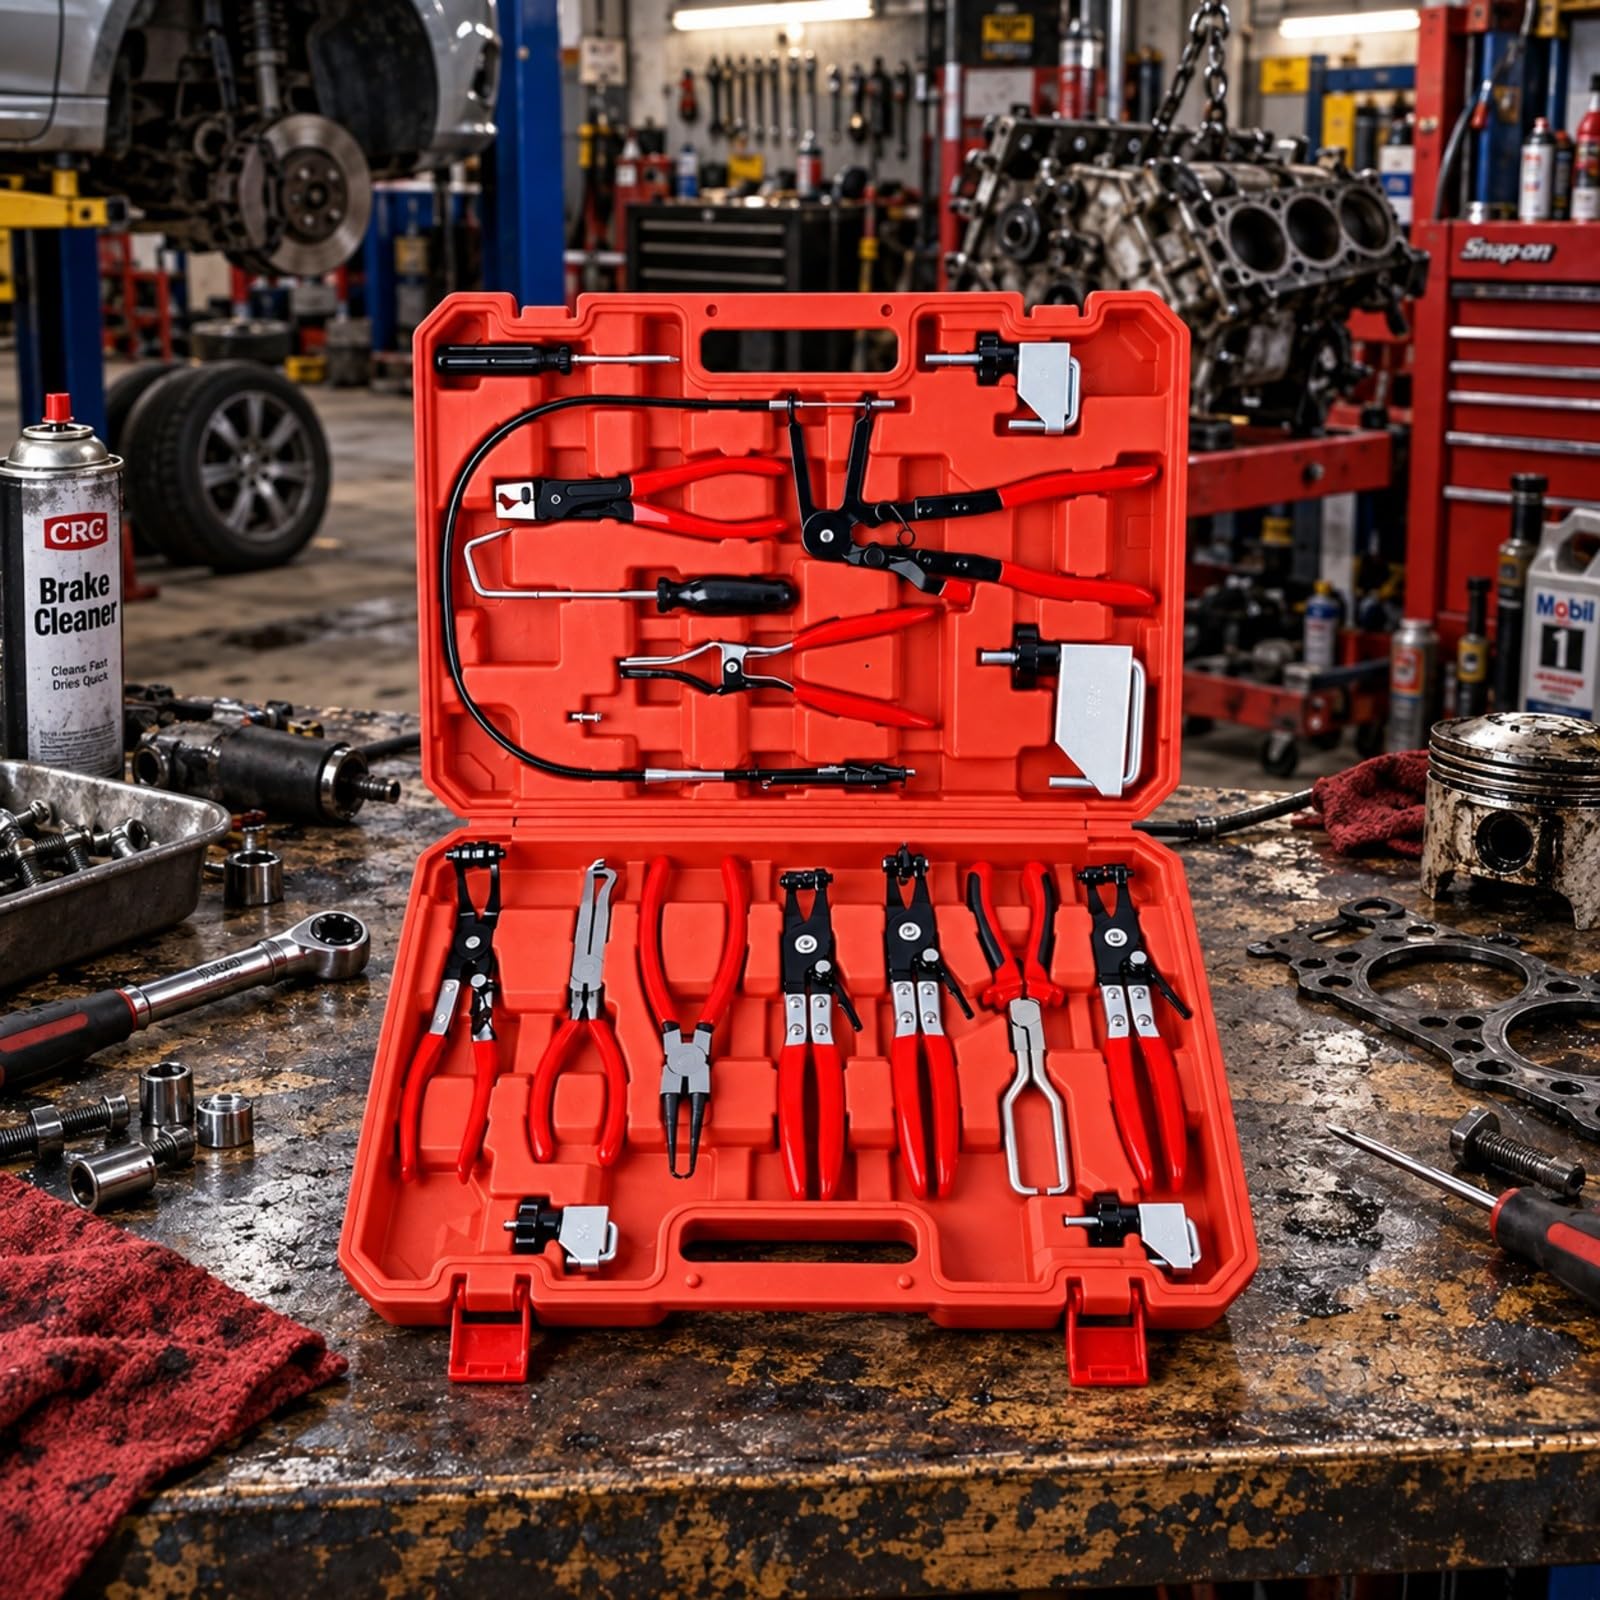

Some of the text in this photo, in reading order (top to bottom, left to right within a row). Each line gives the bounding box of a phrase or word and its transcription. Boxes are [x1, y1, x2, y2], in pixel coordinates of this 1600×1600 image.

[1461, 237, 1553, 264] Snap-on
[50, 518, 105, 545] CRC
[40, 571, 110, 605] Brake
[34, 601, 117, 636] Cleaner
[1537, 593, 1594, 622] Mobil
[1553, 629, 1568, 668] 1
[51, 658, 109, 677] Cleans Fast
[53, 672, 109, 691] Dries Quick
